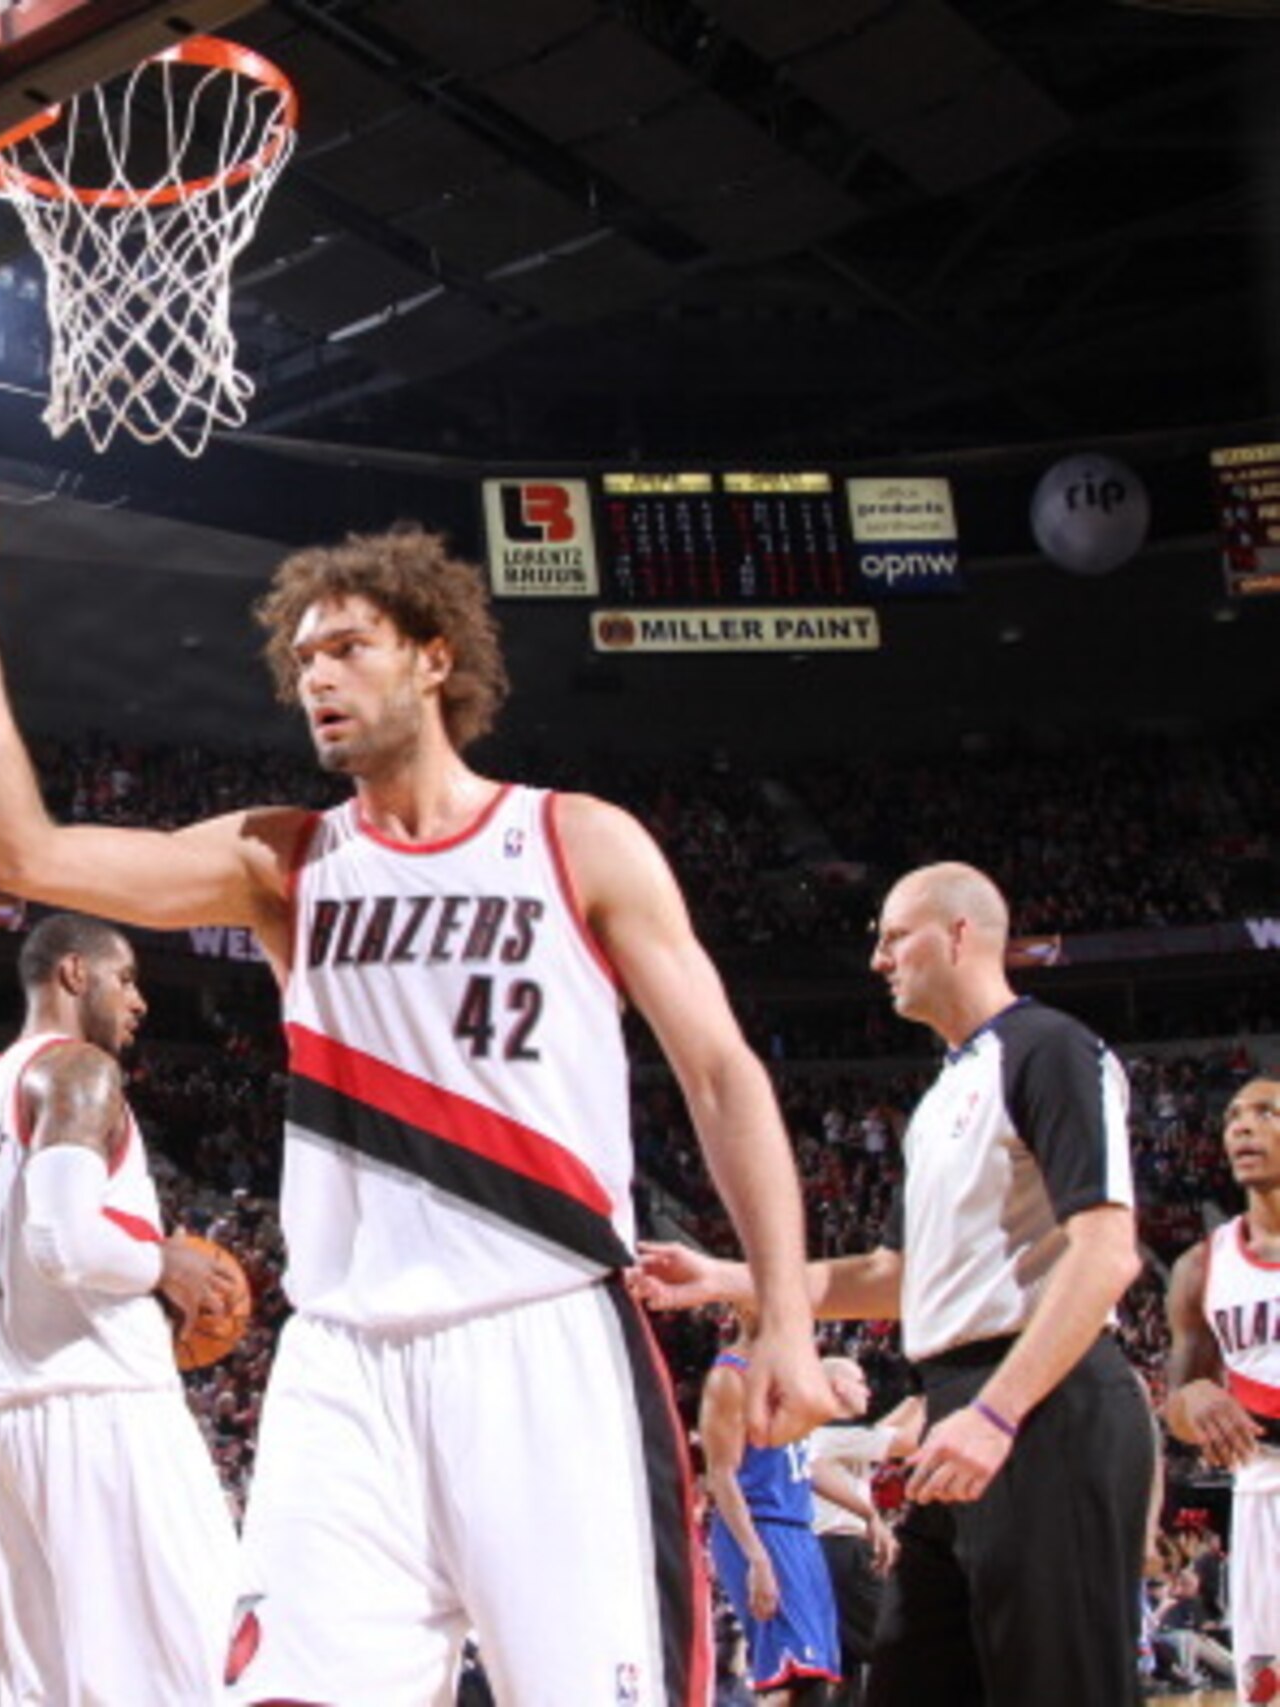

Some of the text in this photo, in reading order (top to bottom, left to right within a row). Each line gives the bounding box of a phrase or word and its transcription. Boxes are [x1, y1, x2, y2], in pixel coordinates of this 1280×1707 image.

[1065, 471, 1125, 514] rip
[860, 552, 958, 587] opnw
[640, 618, 764, 643] MILLER
[774, 616, 871, 640] PAINT
[308, 895, 544, 968] BLAZERS
[453, 973, 544, 1062] 42
